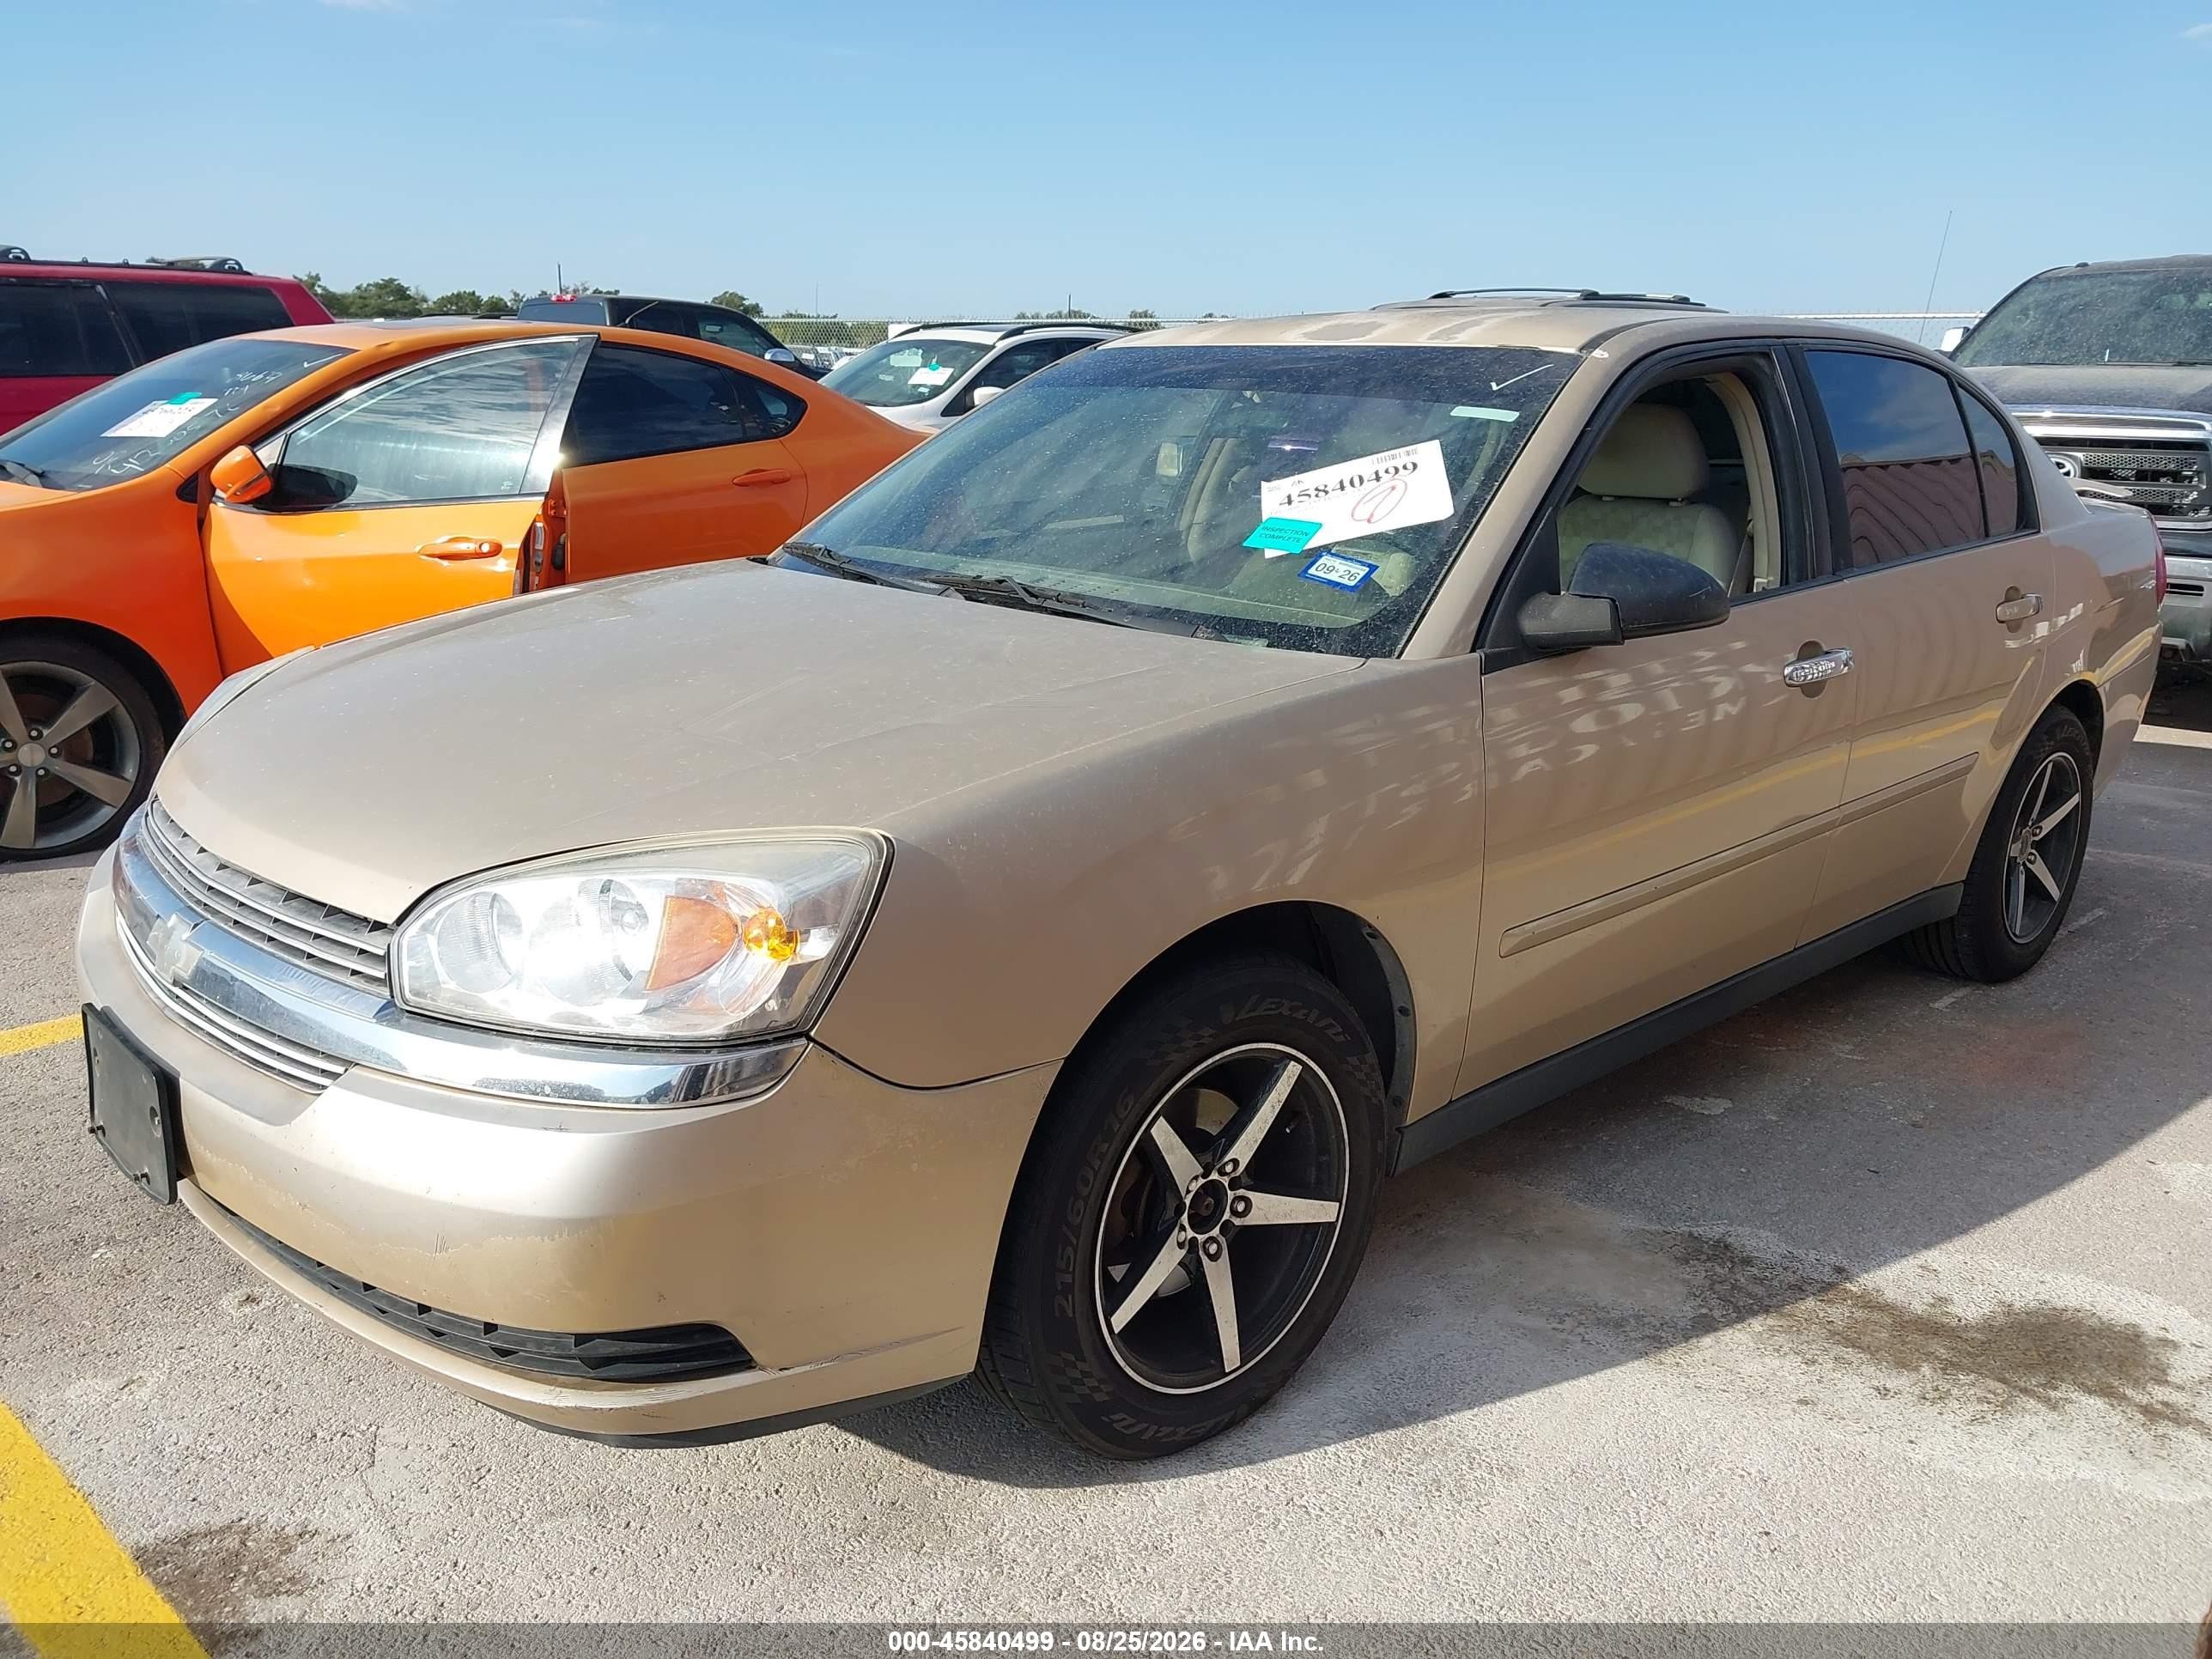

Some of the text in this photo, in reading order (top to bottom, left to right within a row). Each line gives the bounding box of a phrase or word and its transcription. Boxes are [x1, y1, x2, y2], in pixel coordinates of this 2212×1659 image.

[1279, 460, 1419, 507] 45840499
[1259, 532, 1304, 544] COMPLETE
[1261, 525, 1310, 537] INSPECTION
[1054, 1087, 1135, 1319] 215/60R16
